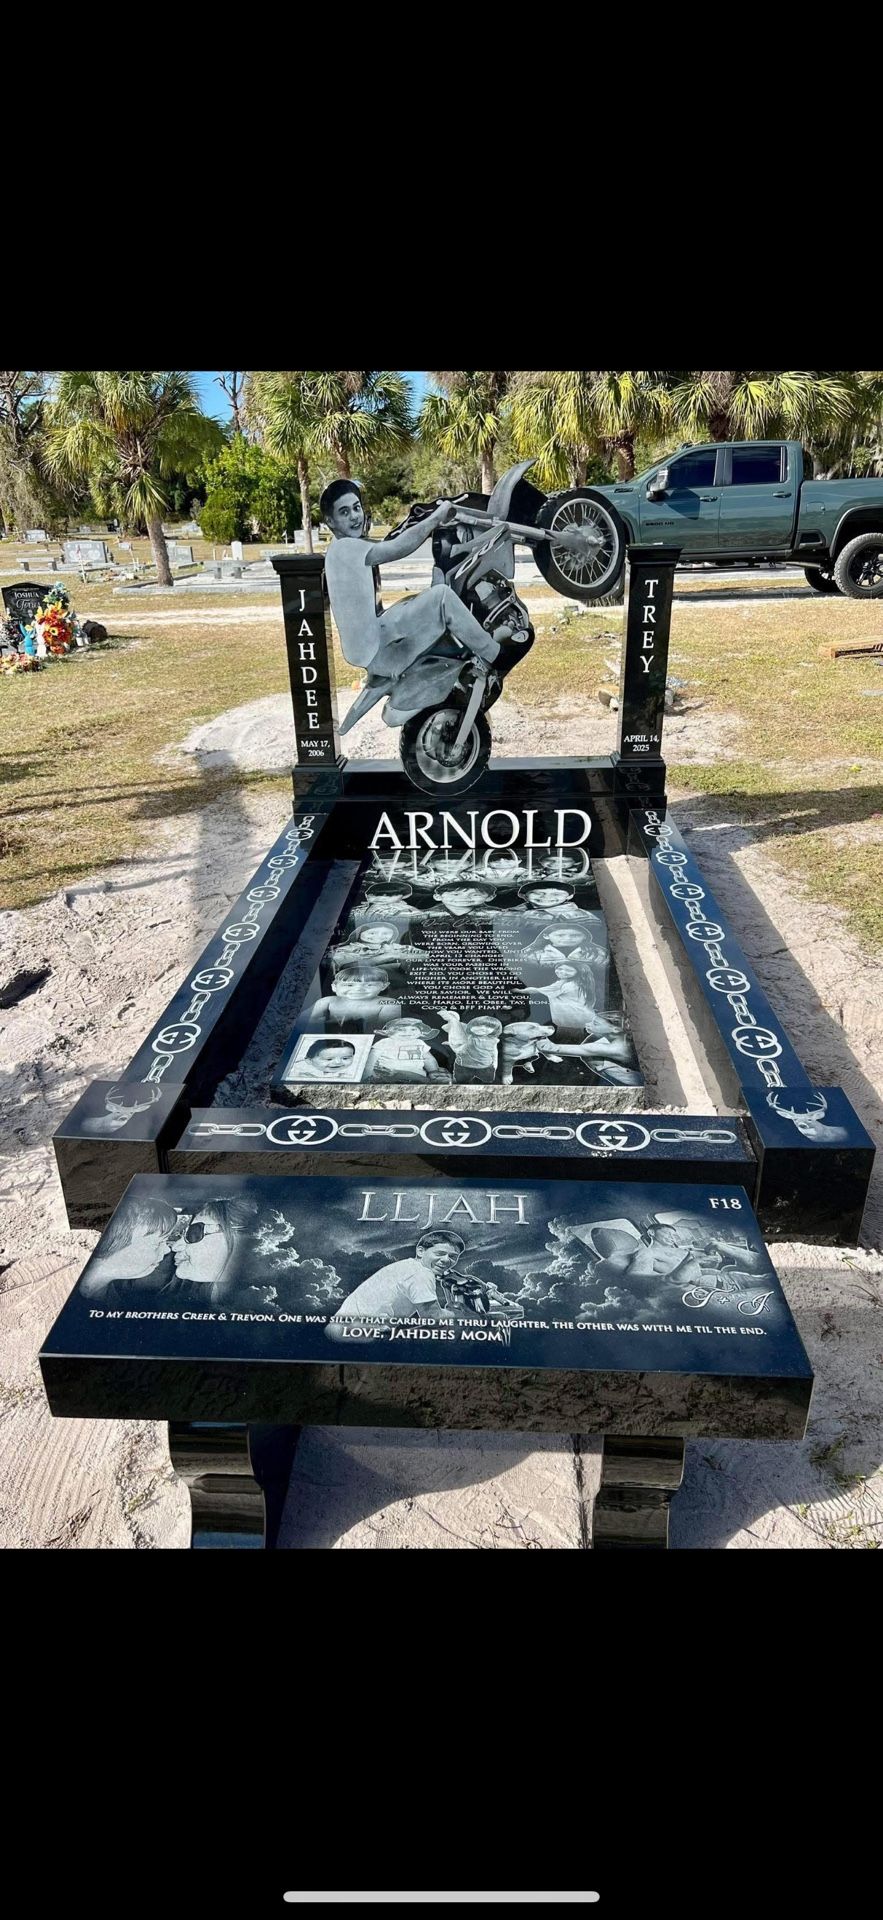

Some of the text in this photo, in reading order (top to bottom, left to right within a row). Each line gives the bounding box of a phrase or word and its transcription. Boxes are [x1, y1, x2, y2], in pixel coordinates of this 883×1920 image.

[640, 579, 658, 673] TREY
[298, 589, 320, 729] JAHDEE
[320, 740, 331, 749] 17,
[649, 735, 660, 744] 14,
[308, 749, 325, 757] 2006
[632, 744, 650, 752] 2025
[367, 809, 592, 849] ARNOLD
[708, 1198, 742, 1210] F18
[89, 1309, 104, 1318] TO
[106, 1311, 124, 1319] MY
[125, 1311, 180, 1320] BROTHERS
[181, 1312, 216, 1320] CREEK
[217, 1313, 227, 1321] &
[230, 1313, 275, 1322] TREVON.
[278, 1314, 302, 1322] ONE
[305, 1315, 327, 1323] WAS
[389, 1317, 435, 1326] CARRIED
[438, 1318, 454, 1326] ME
[457, 1319, 488, 1327] THRU
[552, 1321, 574, 1329] THE
[576, 1322, 615, 1331] OTHER
[616, 1323, 640, 1331] WAS
[642, 1324, 673, 1332] WITH
[676, 1325, 692, 1333] ME
[714, 1326, 737, 1334] THE
[740, 1327, 767, 1335] END.
[342, 1326, 503, 1341] LOVE, JAHDEES MOM
